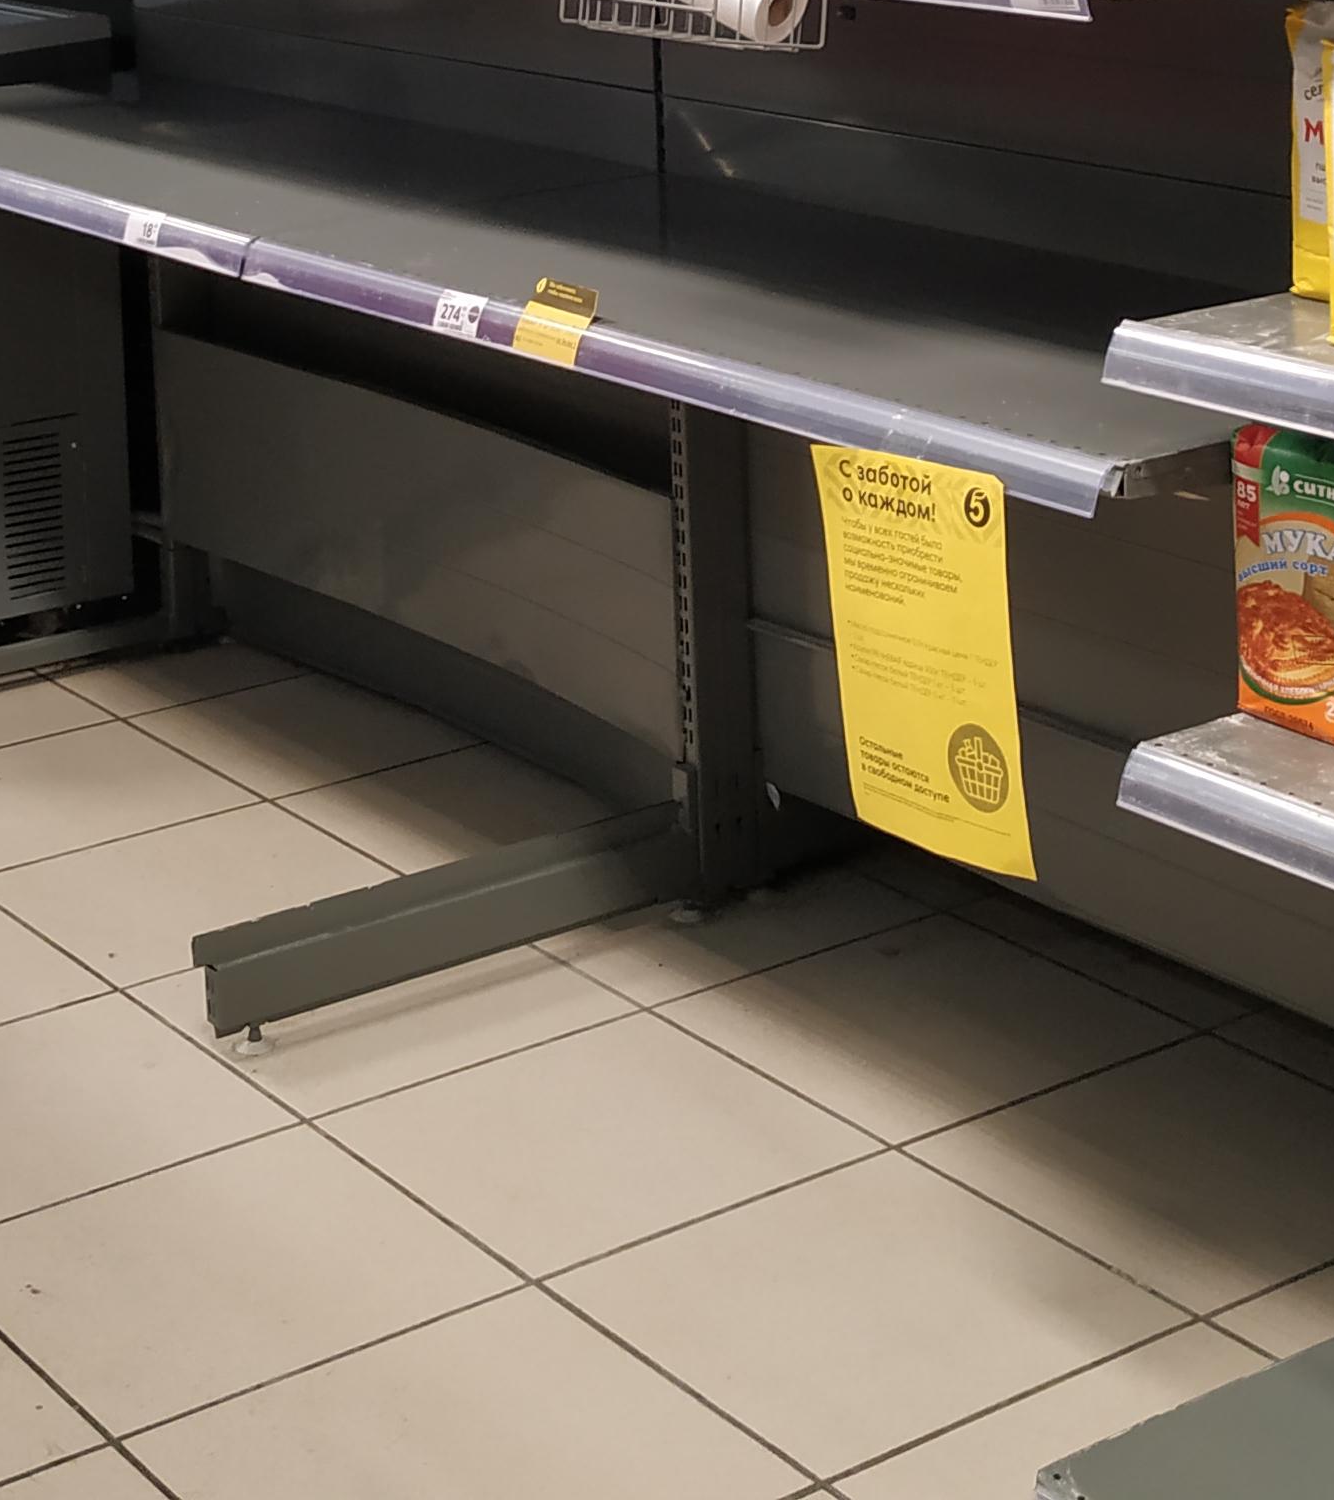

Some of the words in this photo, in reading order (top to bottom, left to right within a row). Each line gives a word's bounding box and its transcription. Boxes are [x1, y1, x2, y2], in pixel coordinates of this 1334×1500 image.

[857, 464, 932, 496] заботой
[1236, 480, 1257, 502] 85
[858, 490, 937, 523] каждом!
[1292, 560, 1329, 576] сорт
